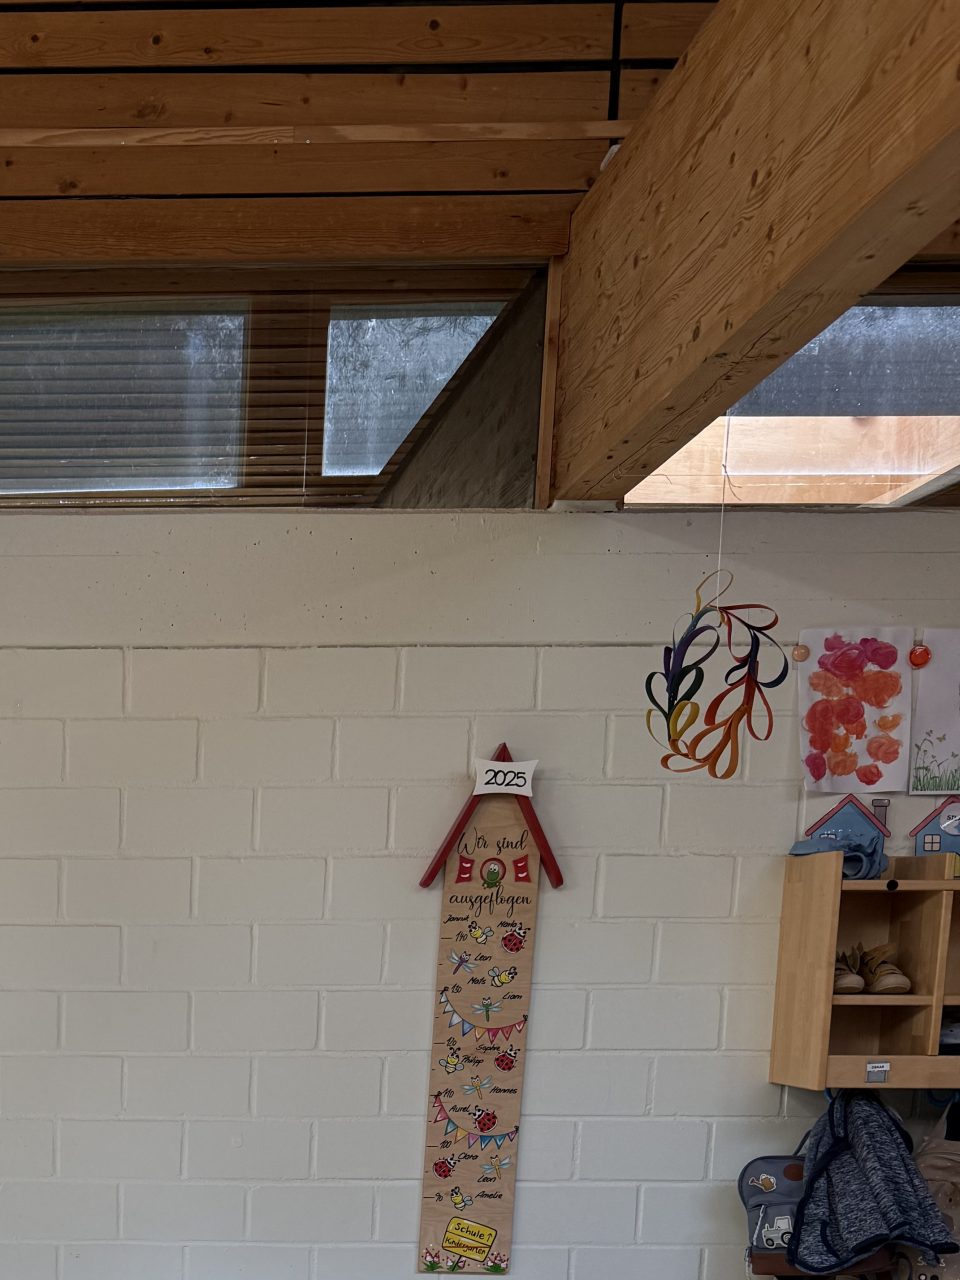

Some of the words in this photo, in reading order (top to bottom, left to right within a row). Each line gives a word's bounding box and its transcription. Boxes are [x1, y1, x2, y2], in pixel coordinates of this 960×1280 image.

[484, 769, 527, 788] 2025
[457, 827, 489, 855] Wir
[496, 829, 529, 855] sind
[449, 884, 532, 918] ausgeflogen
[454, 1222, 485, 1240] Schule
[445, 1237, 486, 1255] Kindergarten
